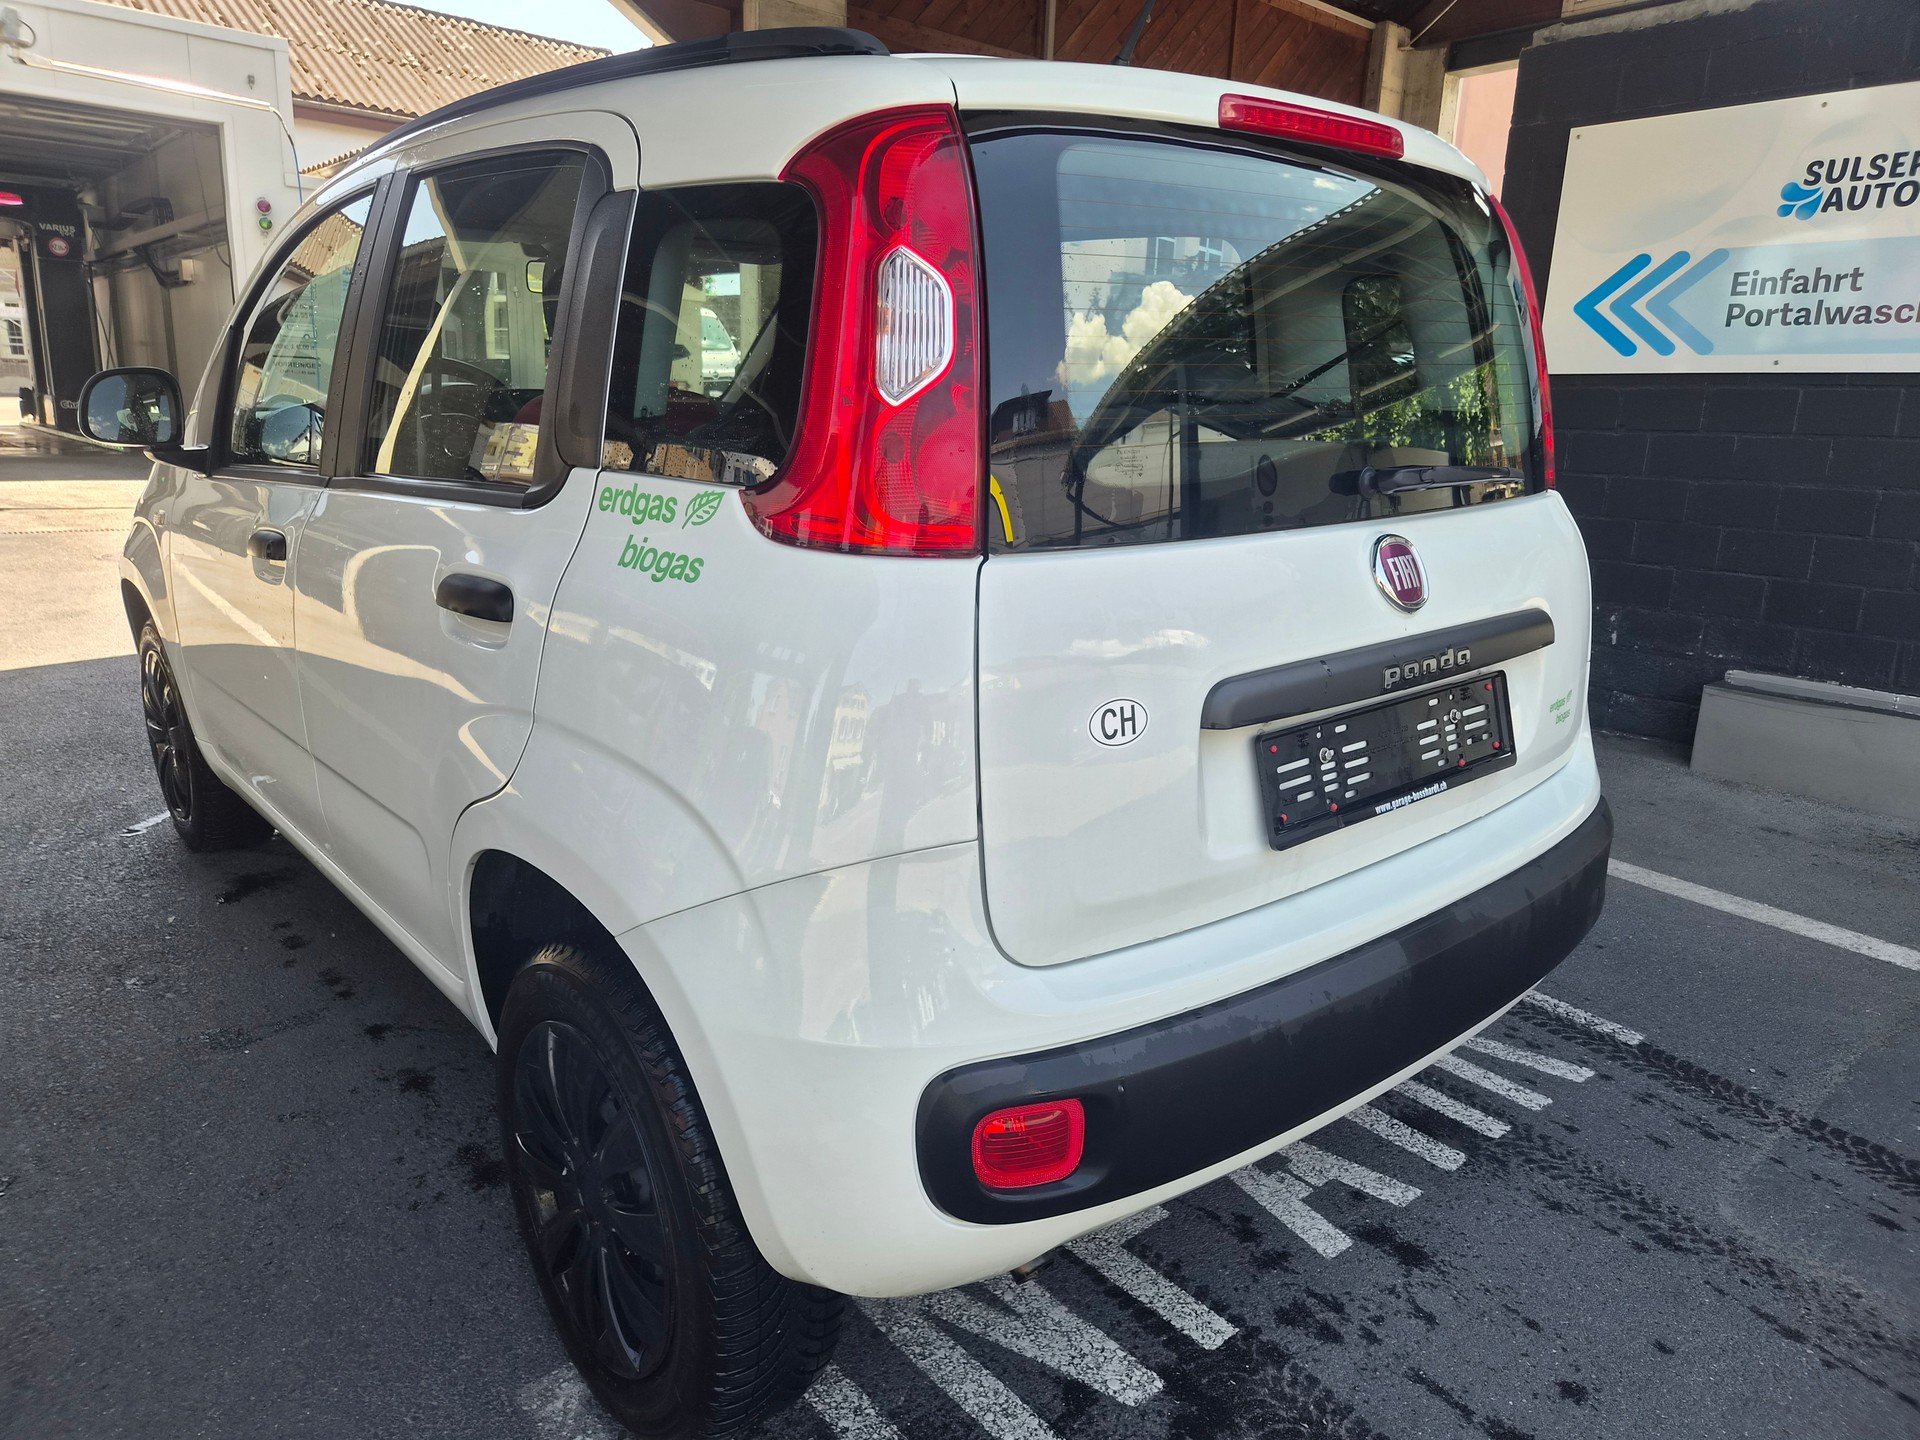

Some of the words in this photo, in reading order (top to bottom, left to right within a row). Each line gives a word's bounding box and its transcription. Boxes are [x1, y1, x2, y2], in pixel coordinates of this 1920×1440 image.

[1730, 267, 1864, 297] Einfahrt
[1725, 300, 1920, 328] Portalwasc
[598, 483, 678, 525] erdgas
[617, 534, 704, 583] biogas
[1386, 554, 1420, 591] FIAT
[1383, 648, 1471, 689] panda
[1101, 705, 1136, 740] CH
[1375, 780, 1448, 815] www.garage-bosshardt.ch
